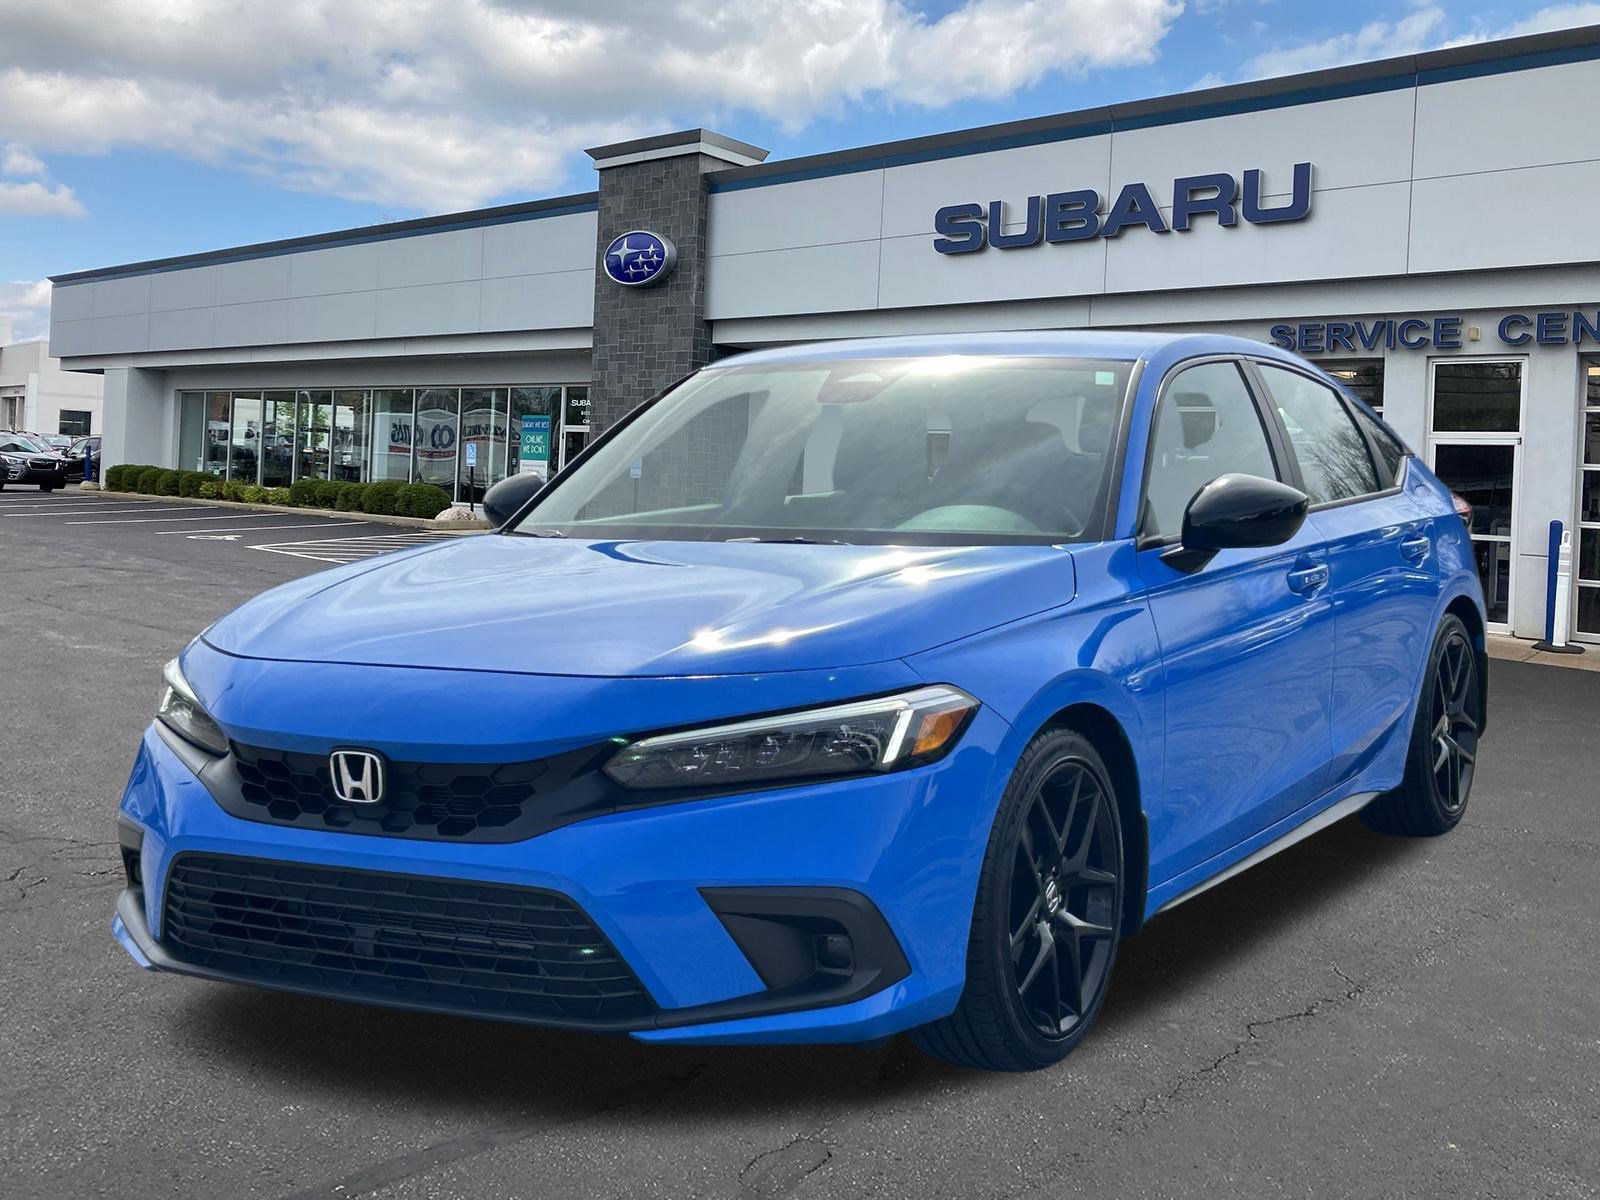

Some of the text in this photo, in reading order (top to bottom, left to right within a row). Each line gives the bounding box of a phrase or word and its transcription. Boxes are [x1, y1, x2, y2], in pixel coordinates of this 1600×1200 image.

[933, 162, 1314, 255] SUBARU
[1269, 311, 1600, 352] SERVICE CEN
